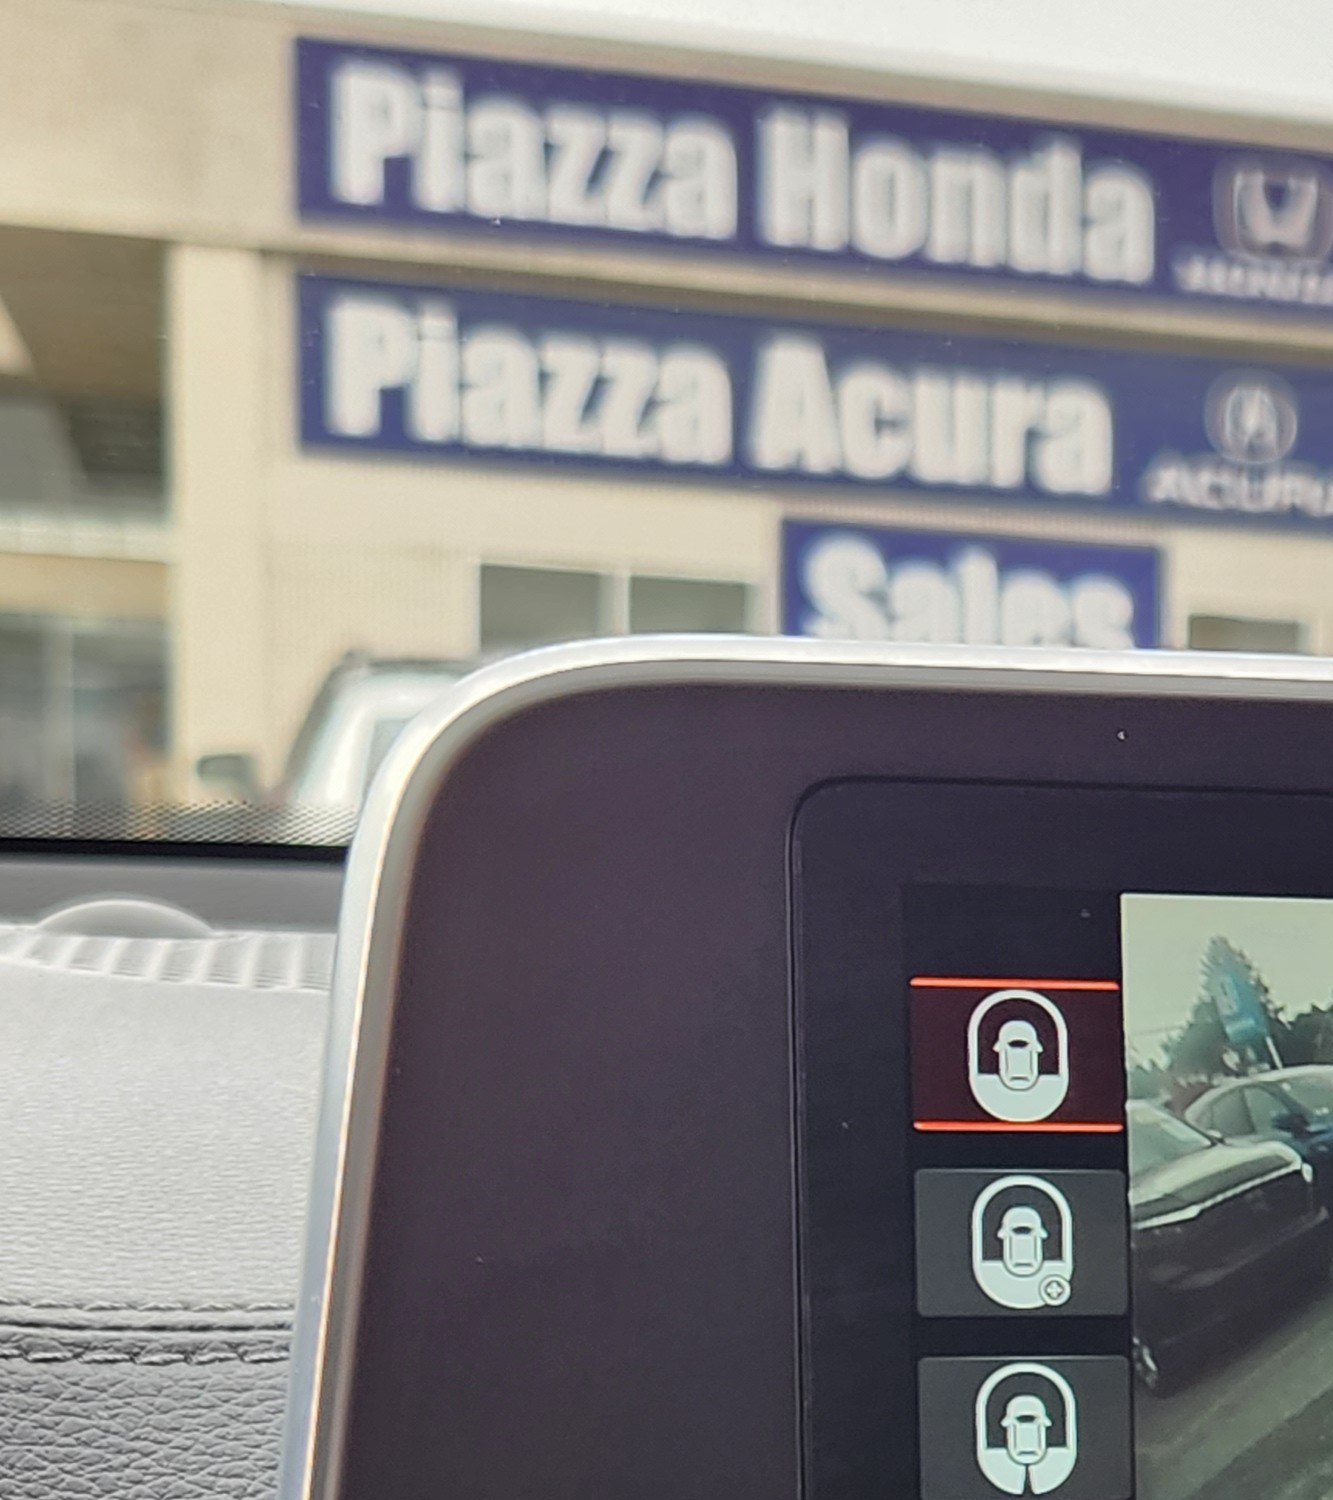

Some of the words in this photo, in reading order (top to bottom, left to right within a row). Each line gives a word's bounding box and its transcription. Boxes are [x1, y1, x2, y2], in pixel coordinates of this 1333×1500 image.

[328, 58, 740, 240] Piazza
[760, 101, 1157, 287] Honda
[325, 296, 734, 467] Piazza
[748, 328, 1115, 498] Acura
[803, 532, 1136, 649] Sales
